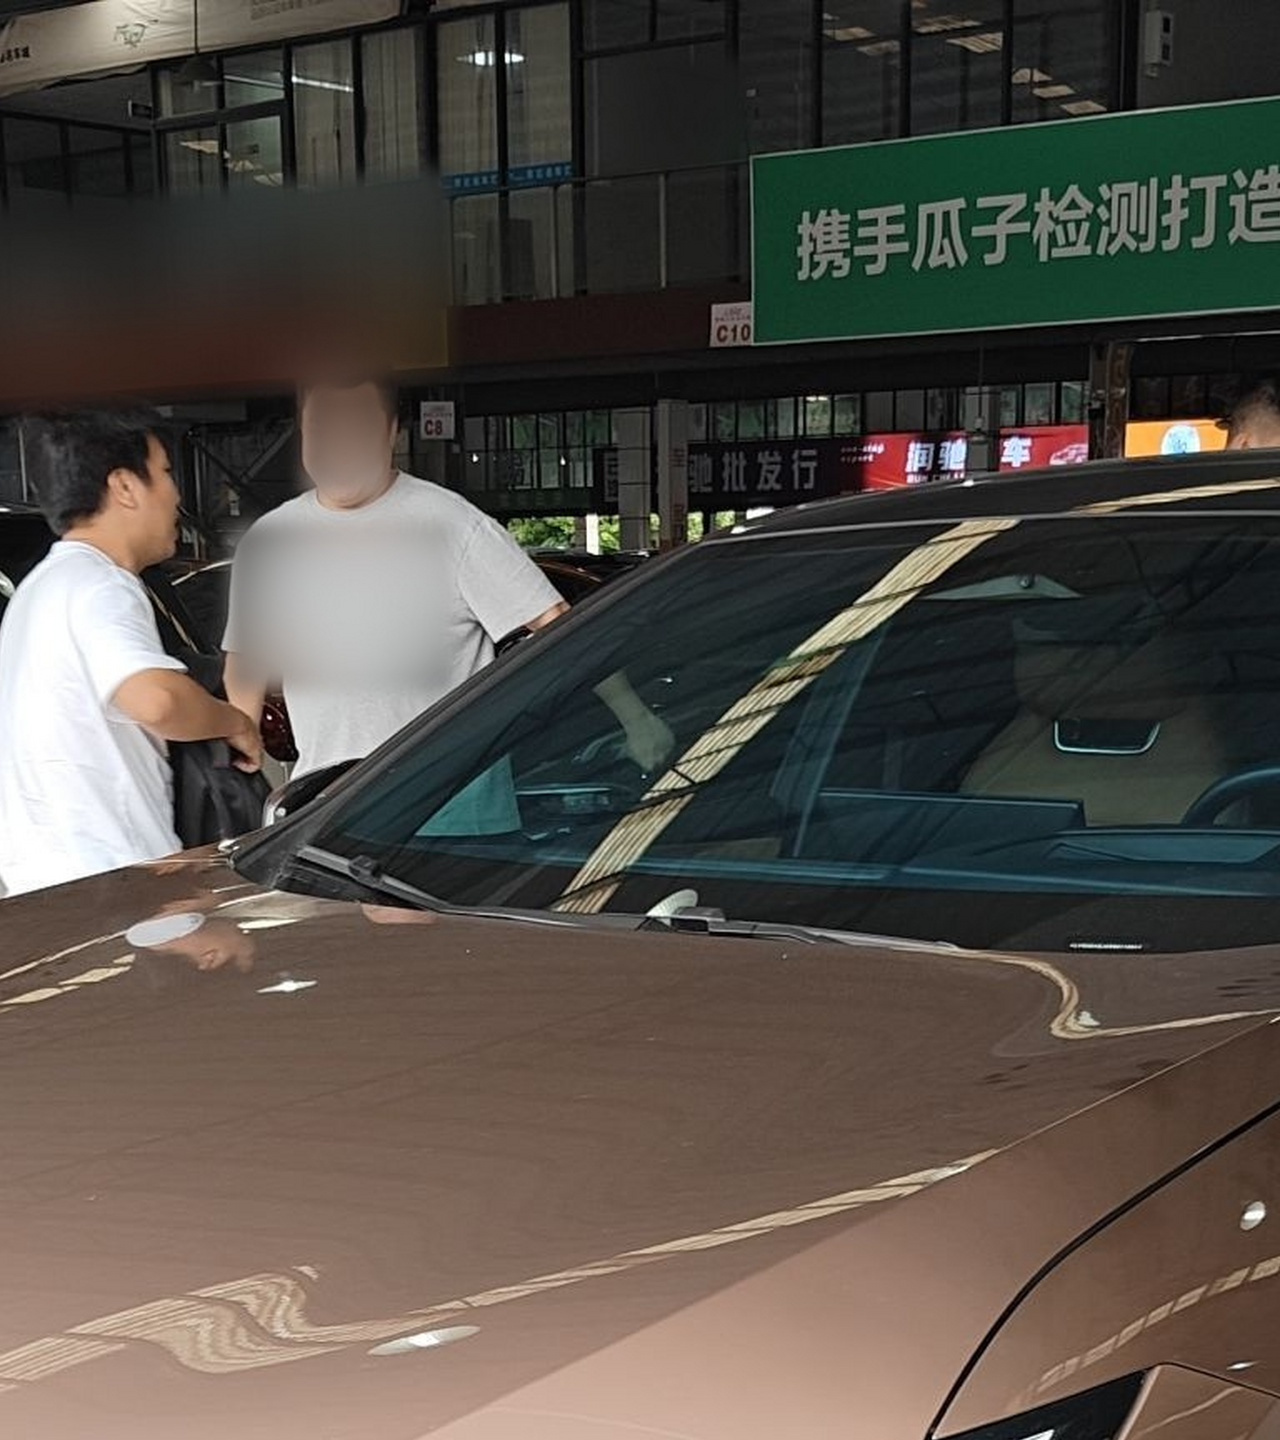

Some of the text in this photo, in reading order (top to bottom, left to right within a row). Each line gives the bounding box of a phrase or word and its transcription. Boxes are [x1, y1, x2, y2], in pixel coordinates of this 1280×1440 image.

[717, 324, 751, 342] C10
[425, 420, 443, 435] C8
[905, 435, 1032, 473] 润驰 车
